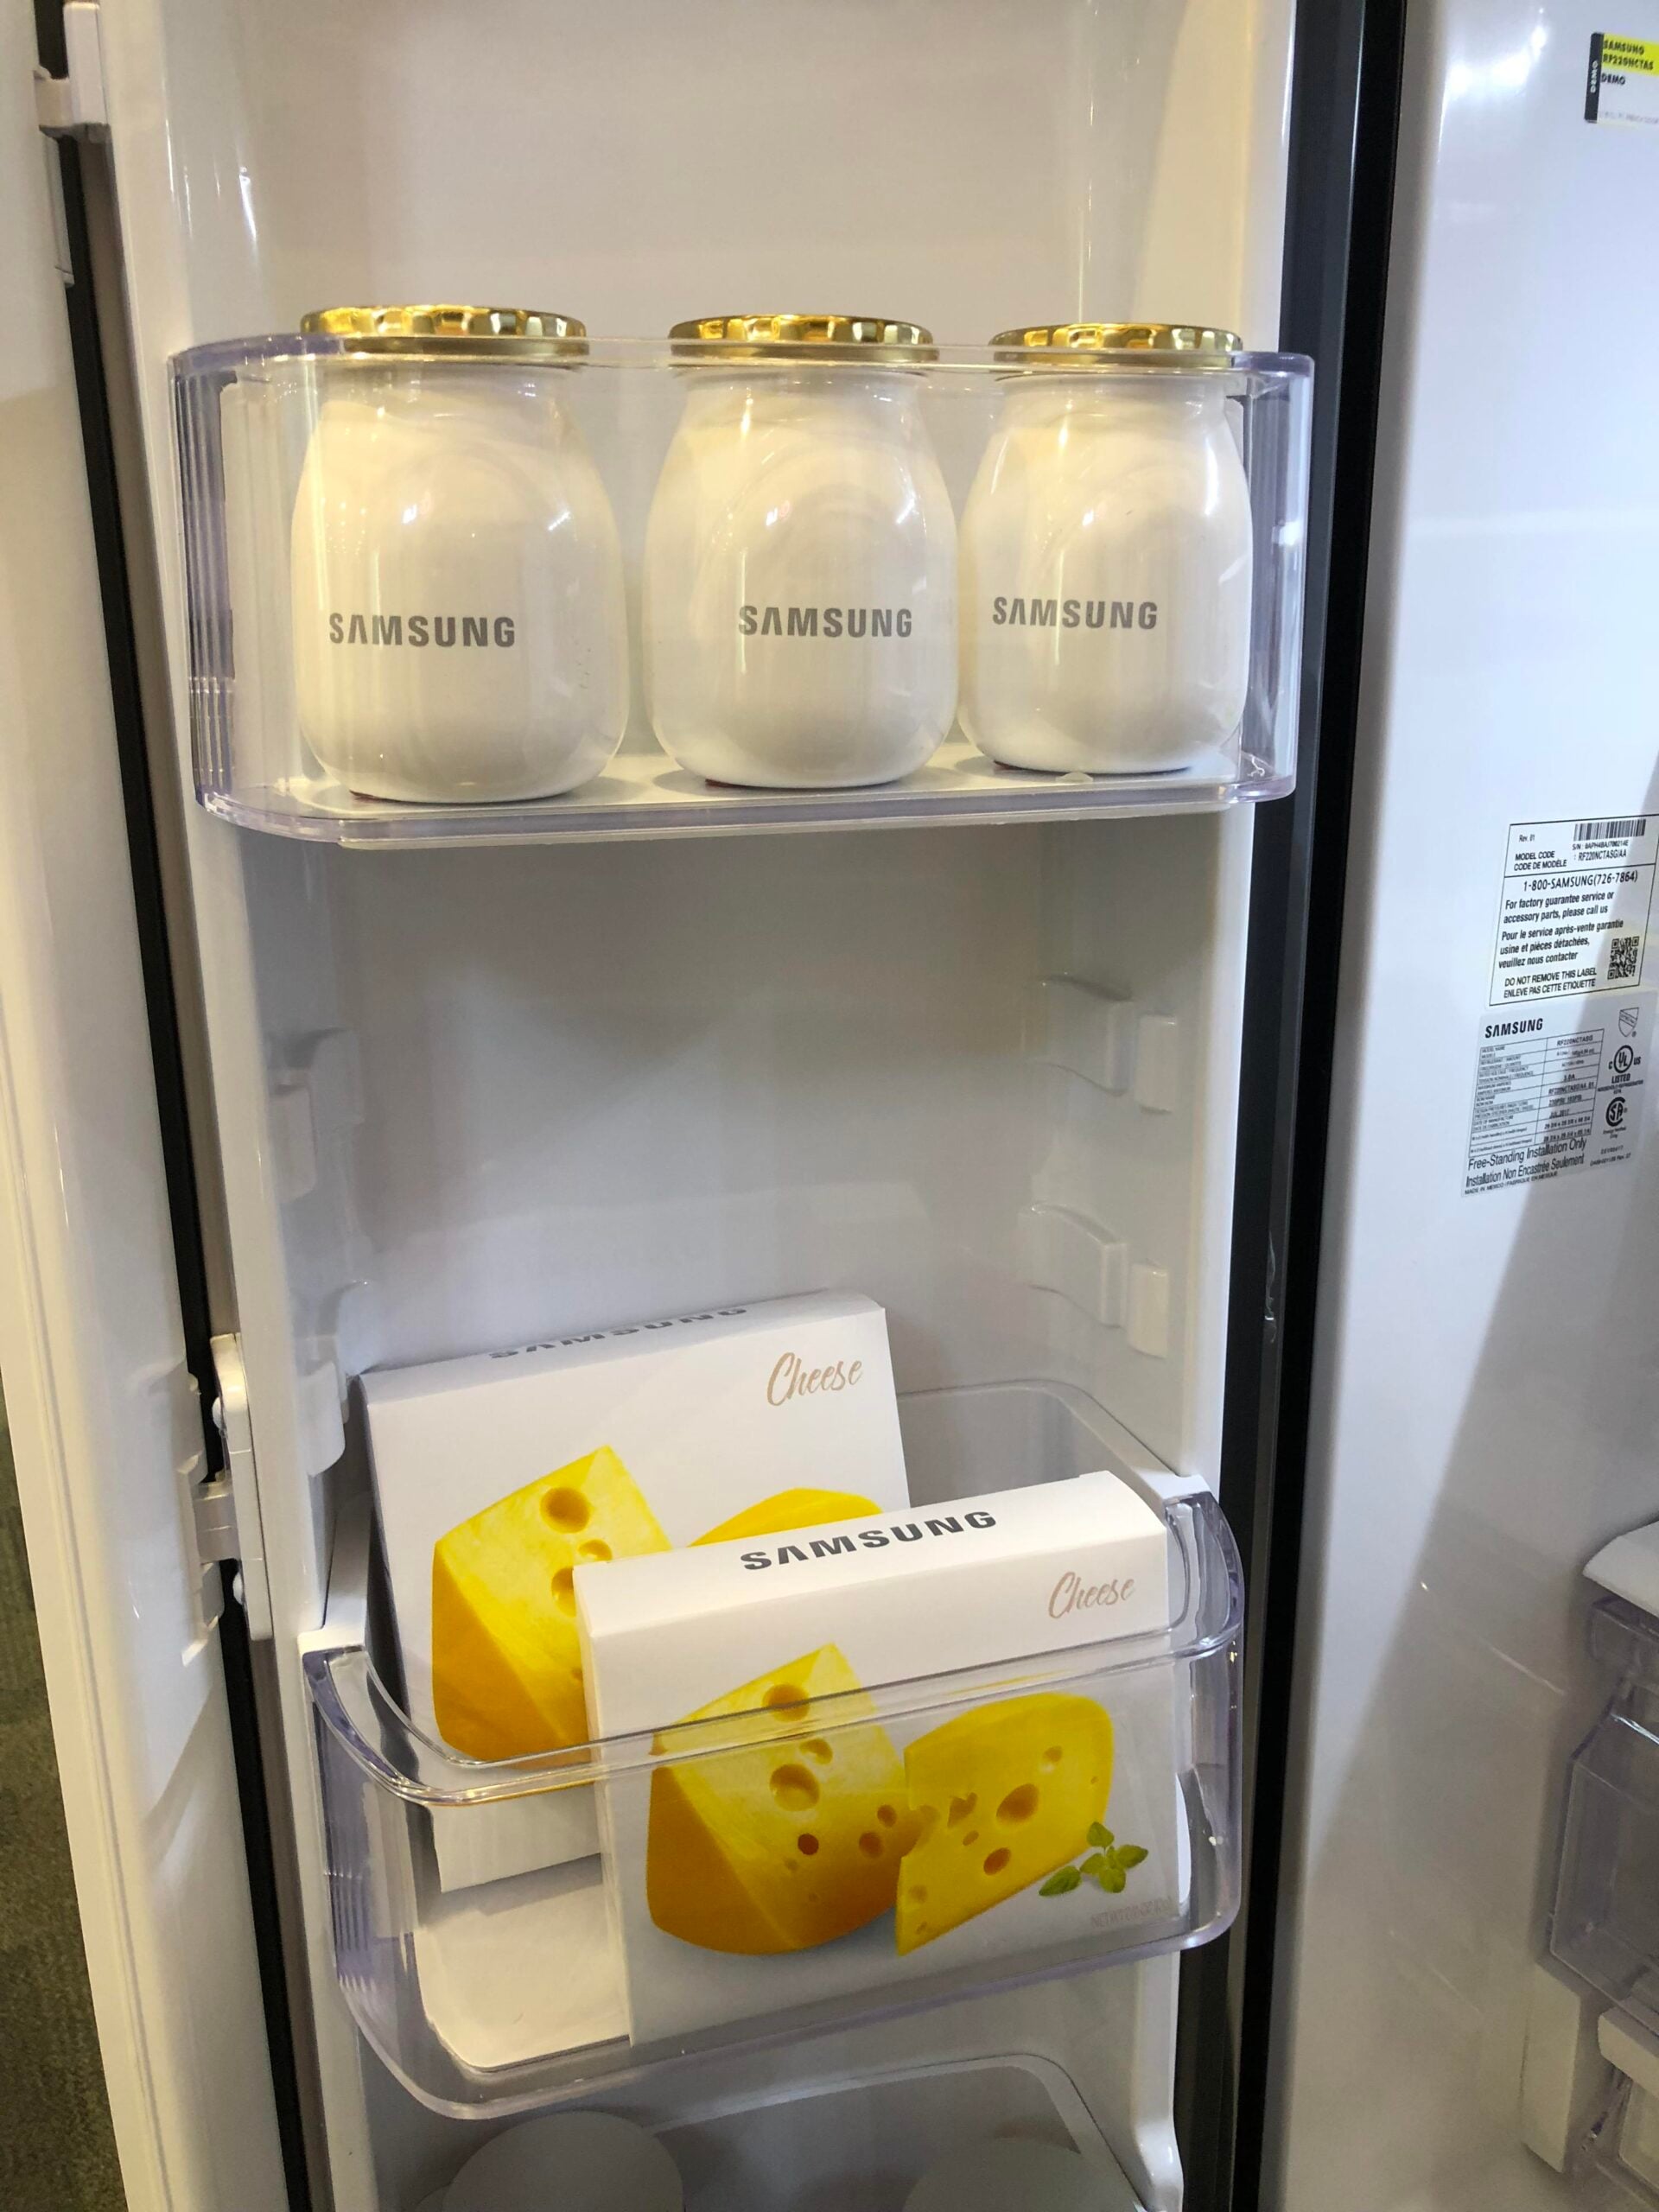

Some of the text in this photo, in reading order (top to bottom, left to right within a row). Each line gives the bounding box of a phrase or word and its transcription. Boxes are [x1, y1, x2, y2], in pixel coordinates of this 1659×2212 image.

[1600, 73, 1626, 86] DEMO
[739, 606, 912, 638] SAMSUNG
[993, 596, 1158, 630] SAMSUNG
[329, 613, 516, 648] SAMSUNG
[1515, 850, 1555, 861] MODEL CODE
[1514, 862, 1532, 871] CODE
[1523, 870, 1638, 892] 1-800-SAMSUNG(726-7864)
[1505, 891, 1615, 910] For factory guarantee service or
[1503, 905, 1608, 925] accessory parts, please call us
[1501, 931, 1517, 941] Pour
[1520, 929, 1527, 938] le
[1528, 927, 1553, 938] service
[1596, 919, 1624, 933] garantie
[1498, 951, 1579, 969] veuillez nous contacter
[1500, 944, 1519, 956] usine
[1521, 944, 1529, 953] et
[1504, 967, 1598, 987] DO NOT REMOVE THIS LABEL
[1503, 978, 1596, 998] ENLEVE PAS CETTE ETIQUETTE
[1484, 1018, 1543, 1039] SAMSUNG
[1611, 1072, 1631, 1084] LISTED
[1468, 1150, 1525, 1172] Free-Standing
[1526, 1141, 1565, 1160] Installation
[1569, 1136, 1587, 1152] Only
[1465, 1172, 1502, 1188] Installation
[1503, 1167, 1517, 1179] Non
[1550, 1154, 1585, 1170] Seulement
[767, 1351, 862, 1407] Cheese
[741, 1510, 998, 1571] SAMSUNG
[1048, 1571, 1135, 1619] Cheese
